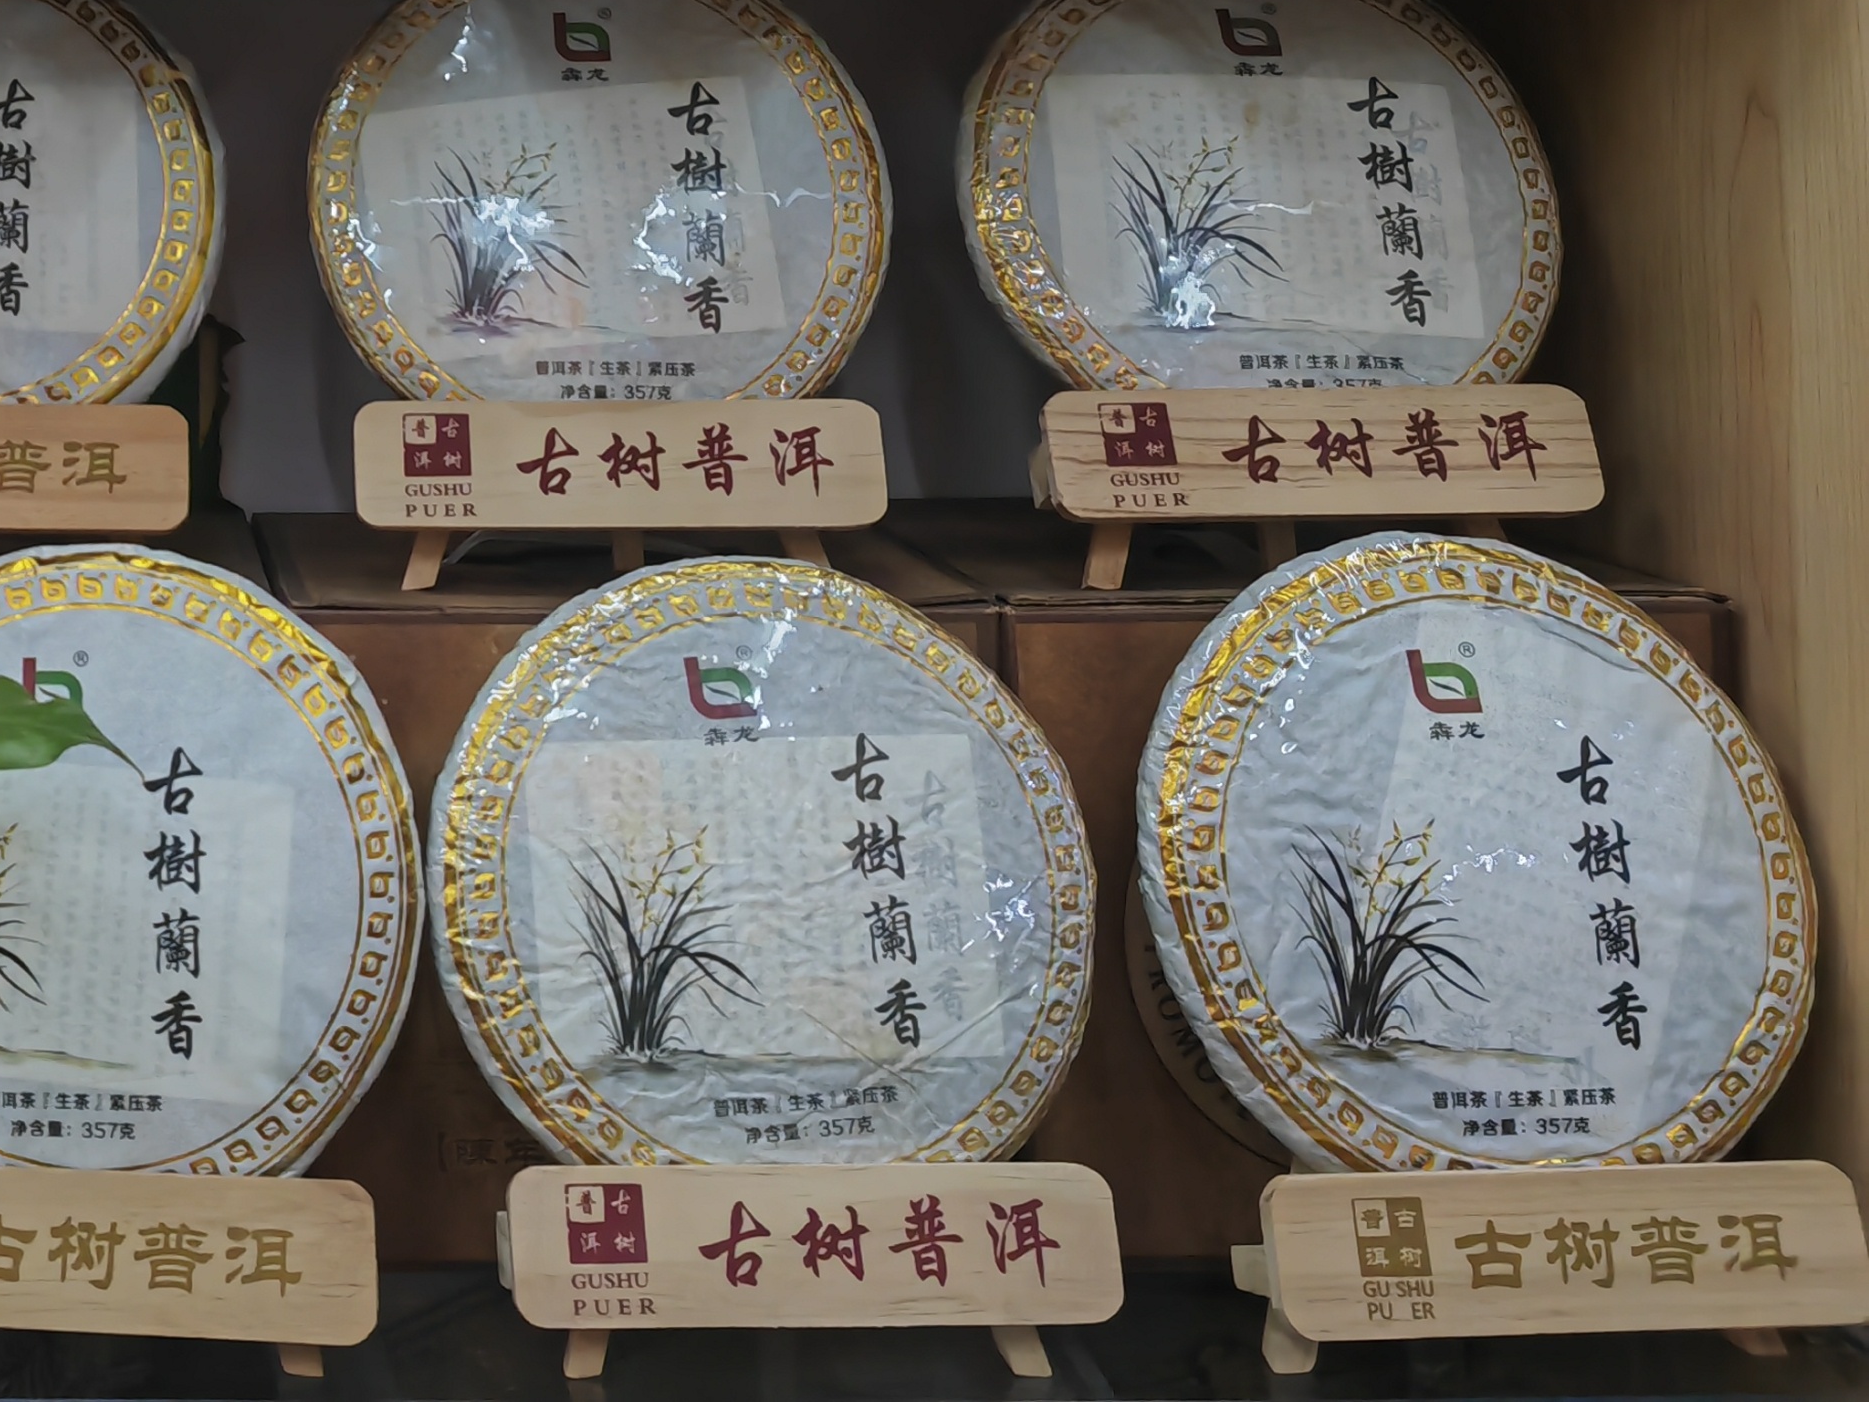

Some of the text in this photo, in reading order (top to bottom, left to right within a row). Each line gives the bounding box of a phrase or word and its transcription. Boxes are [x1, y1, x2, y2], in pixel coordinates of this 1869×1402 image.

[667, 81, 730, 334] 古樹蘭香
[1347, 76, 1433, 328] 古樹蘭香
[516, 422, 833, 497] 古树普洱
[1110, 472, 1180, 488] GUSHU
[1222, 408, 1548, 484] 古树普洱
[404, 483, 471, 497] GUSHU
[405, 503, 477, 518] PUER
[1113, 493, 1189, 509] PUER
[143, 747, 207, 1060] 古樹蘭香
[831, 732, 929, 1049] 古樹蘭香
[1557, 735, 1648, 1051] 古樹蘭香
[698, 1193, 1061, 1288] 古树普洱
[1454, 1212, 1798, 1290] 古树普洱
[572, 1272, 649, 1289] GUSHU
[573, 1298, 656, 1316] PUER
[1363, 1280, 1434, 1297] GU SHU
[1368, 1302, 1436, 1319] PU ER
